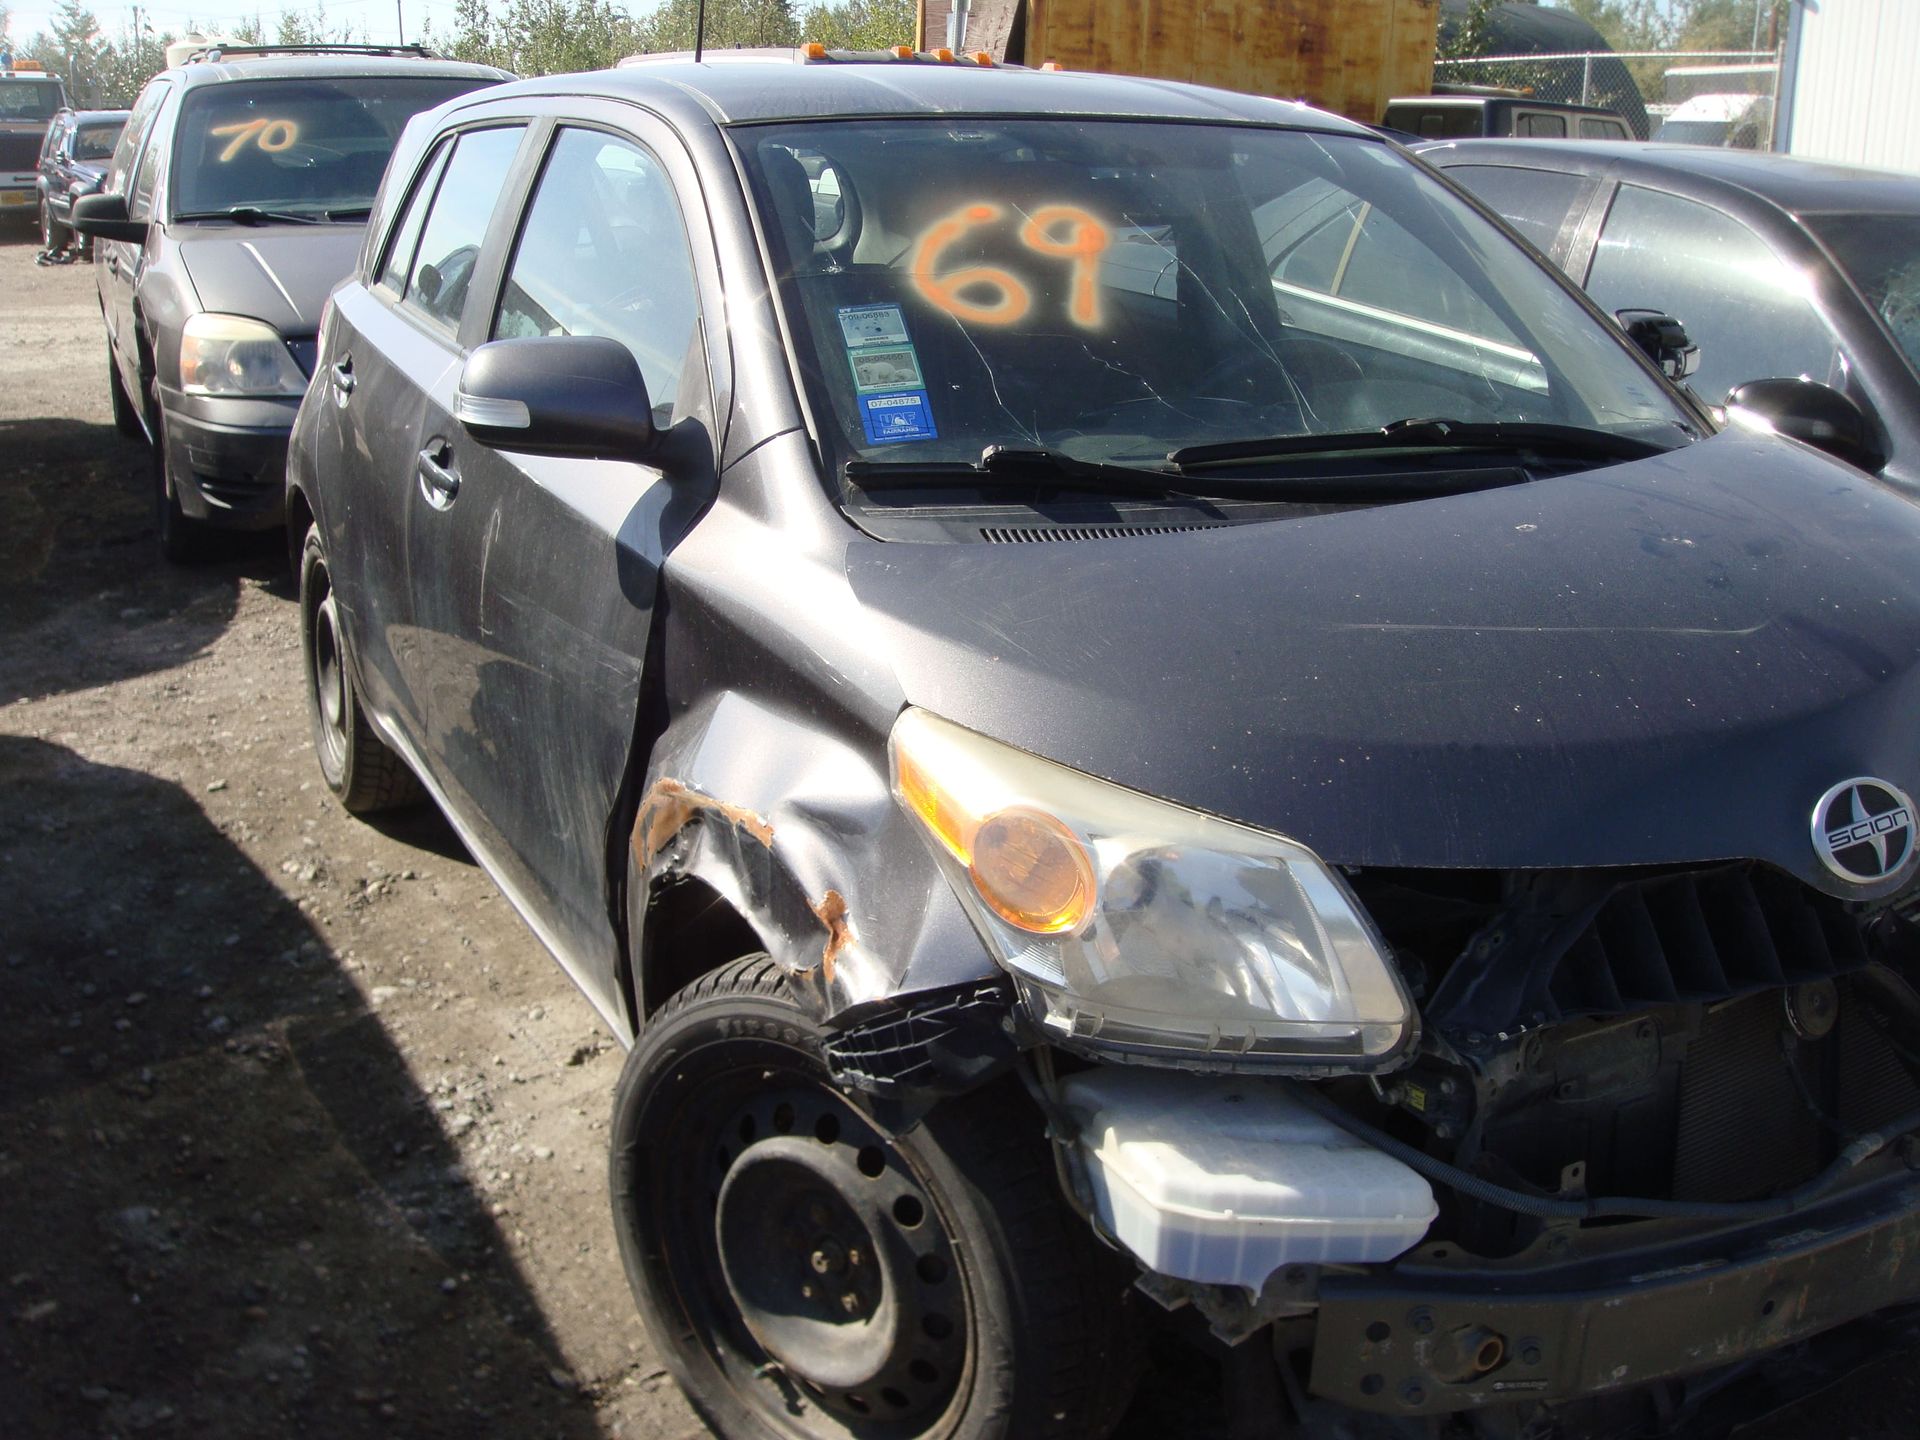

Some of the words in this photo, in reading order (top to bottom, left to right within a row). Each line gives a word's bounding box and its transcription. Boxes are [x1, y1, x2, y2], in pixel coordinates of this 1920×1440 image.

[211, 118, 299, 162] 70
[911, 203, 1111, 330] 69
[870, 398, 917, 408] 07-04875
[880, 411, 916, 428] UAF
